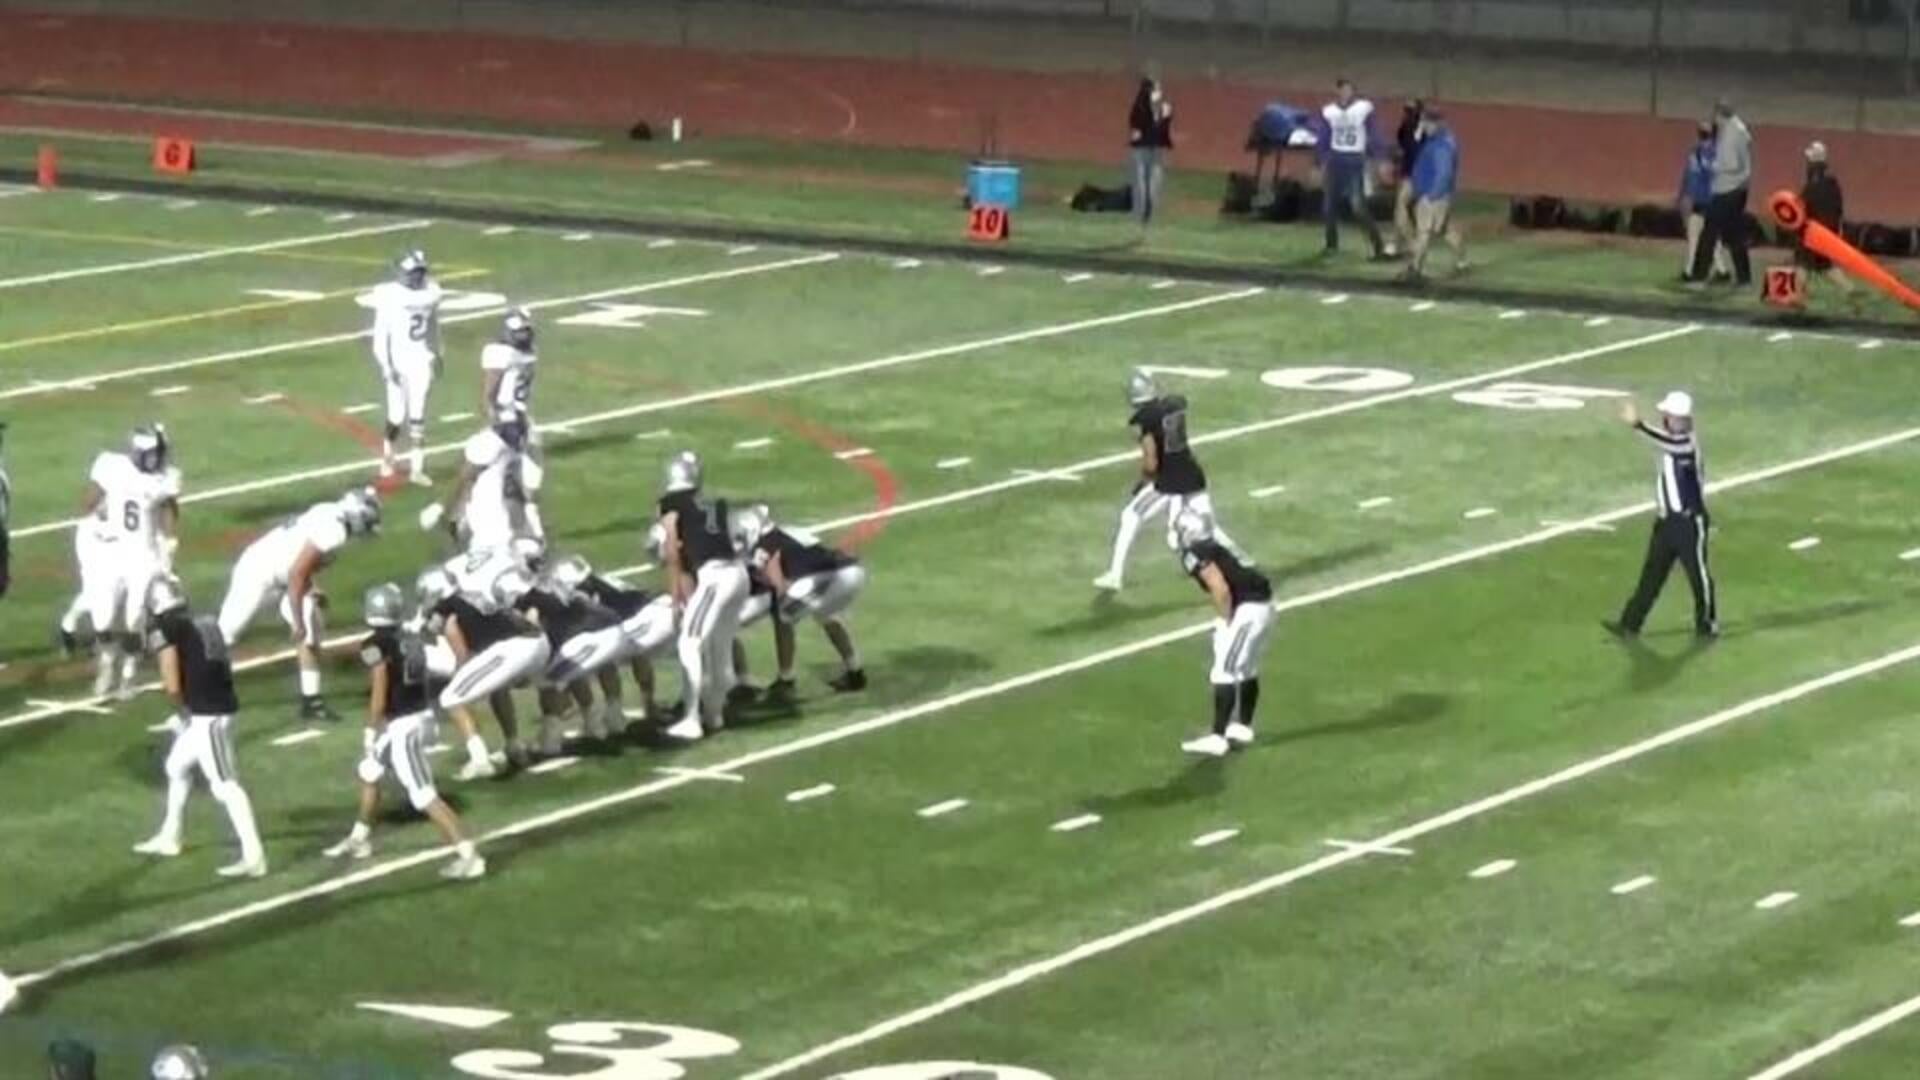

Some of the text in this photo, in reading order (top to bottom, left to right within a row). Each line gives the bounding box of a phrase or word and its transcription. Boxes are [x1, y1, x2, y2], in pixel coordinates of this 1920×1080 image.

[972, 208, 999, 234] 10
[124, 500, 139, 532] 6
[451, 1021, 741, 1080] 3
